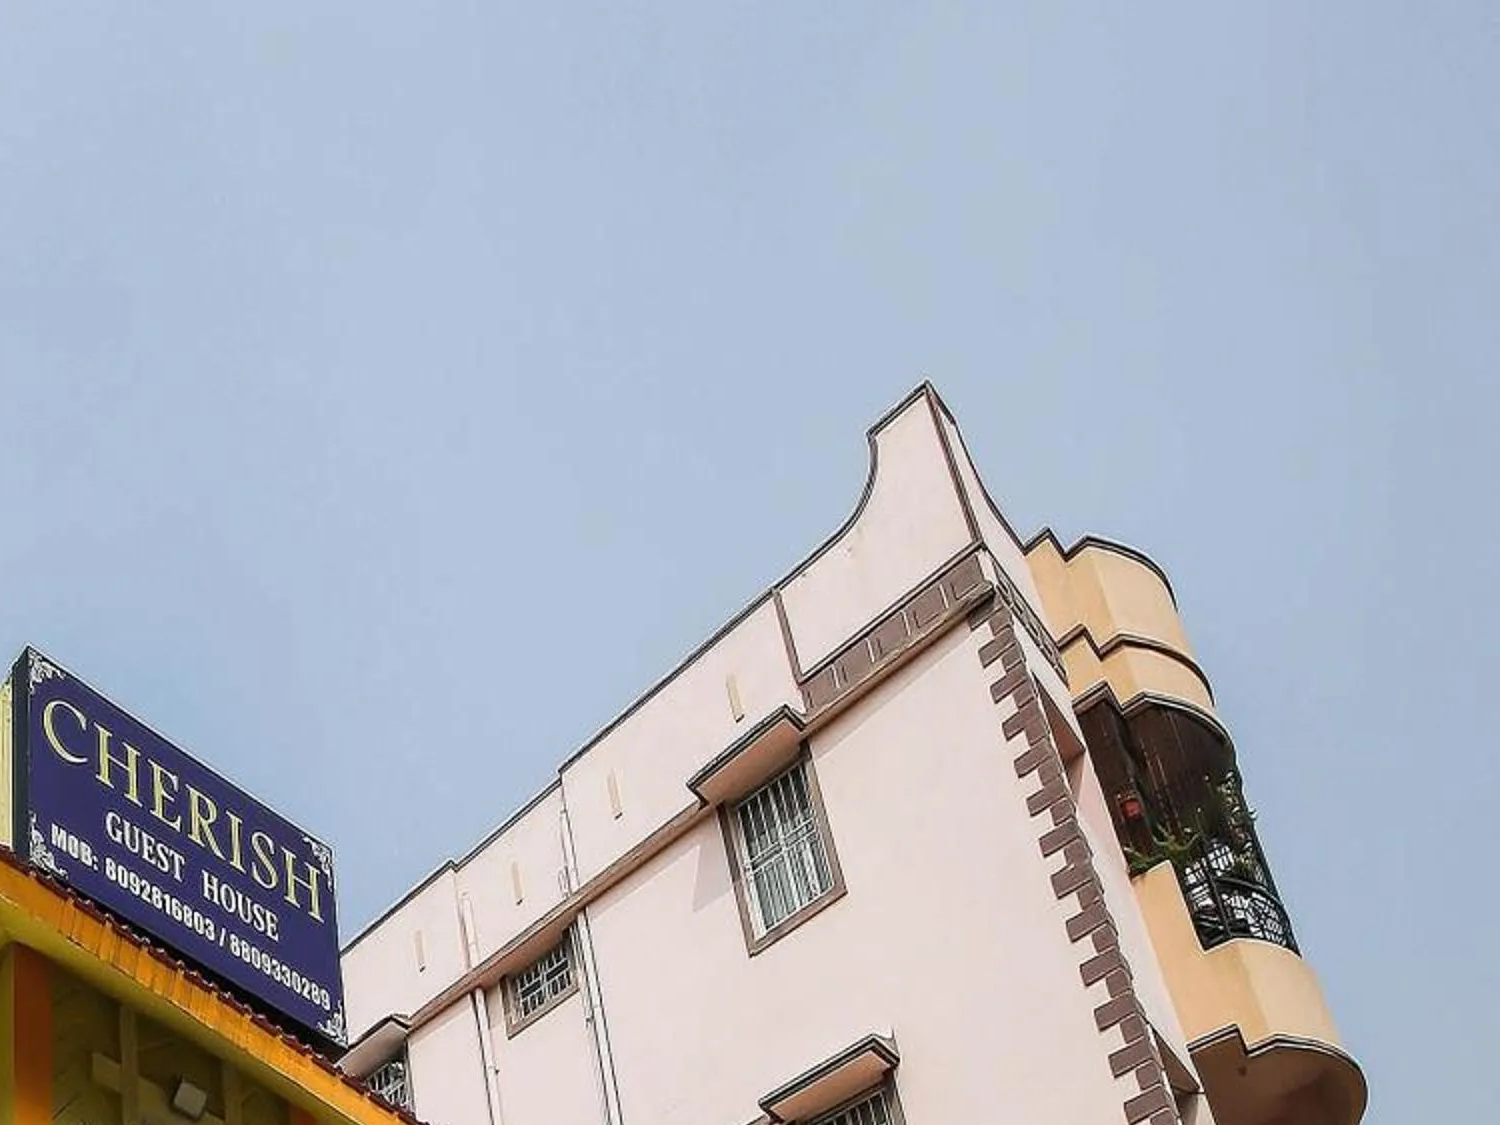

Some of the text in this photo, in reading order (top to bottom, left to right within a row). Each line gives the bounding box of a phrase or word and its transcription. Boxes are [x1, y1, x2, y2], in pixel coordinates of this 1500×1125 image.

[43, 700, 325, 923] CHERISH
[51, 823, 99, 871] MOB:
[105, 811, 279, 942] GUEST HOUSE
